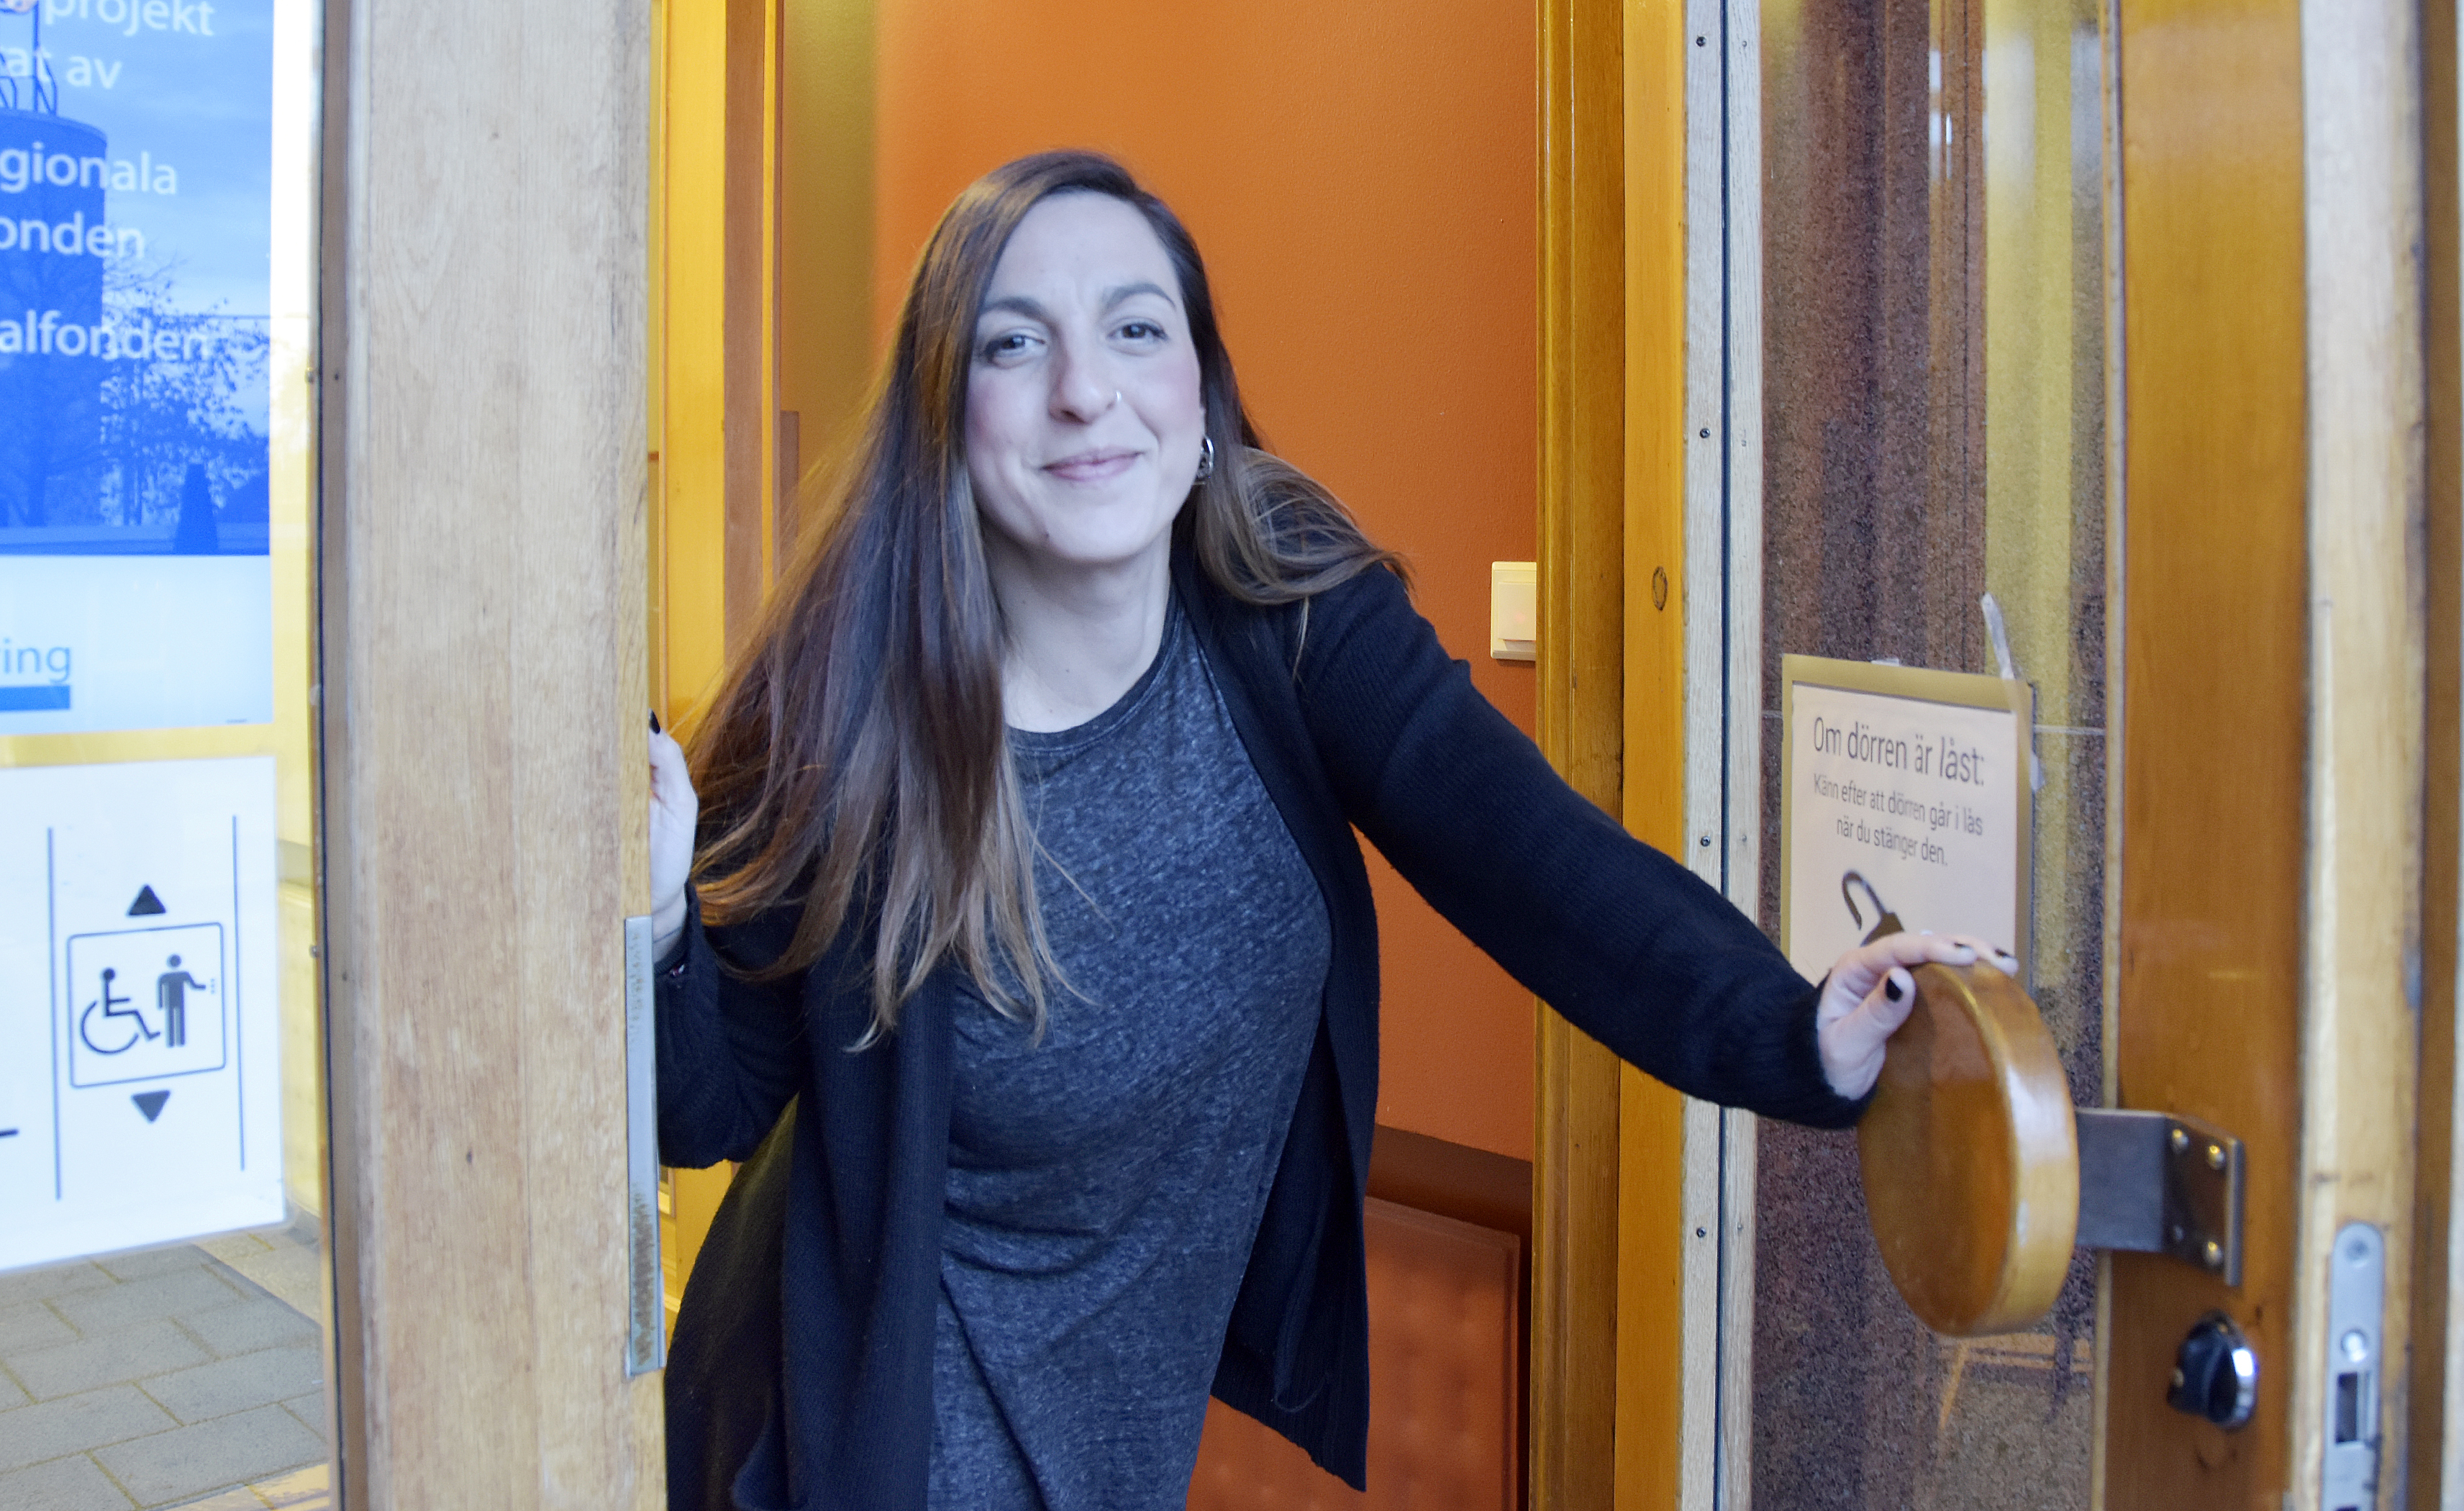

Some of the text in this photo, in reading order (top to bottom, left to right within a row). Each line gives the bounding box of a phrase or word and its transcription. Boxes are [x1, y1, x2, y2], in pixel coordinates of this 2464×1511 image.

[43, 0, 214, 37] projekt
[0, 45, 122, 90] at av
[0, 141, 177, 194] gionala
[0, 309, 212, 361] alfonden
[2, 637, 72, 684] ing
[1814, 717, 1984, 786] Om dörren är låst:
[1814, 773, 1983, 836] Känn efter att dörren går i lås
[1837, 815, 1948, 866] när du stänger den.
